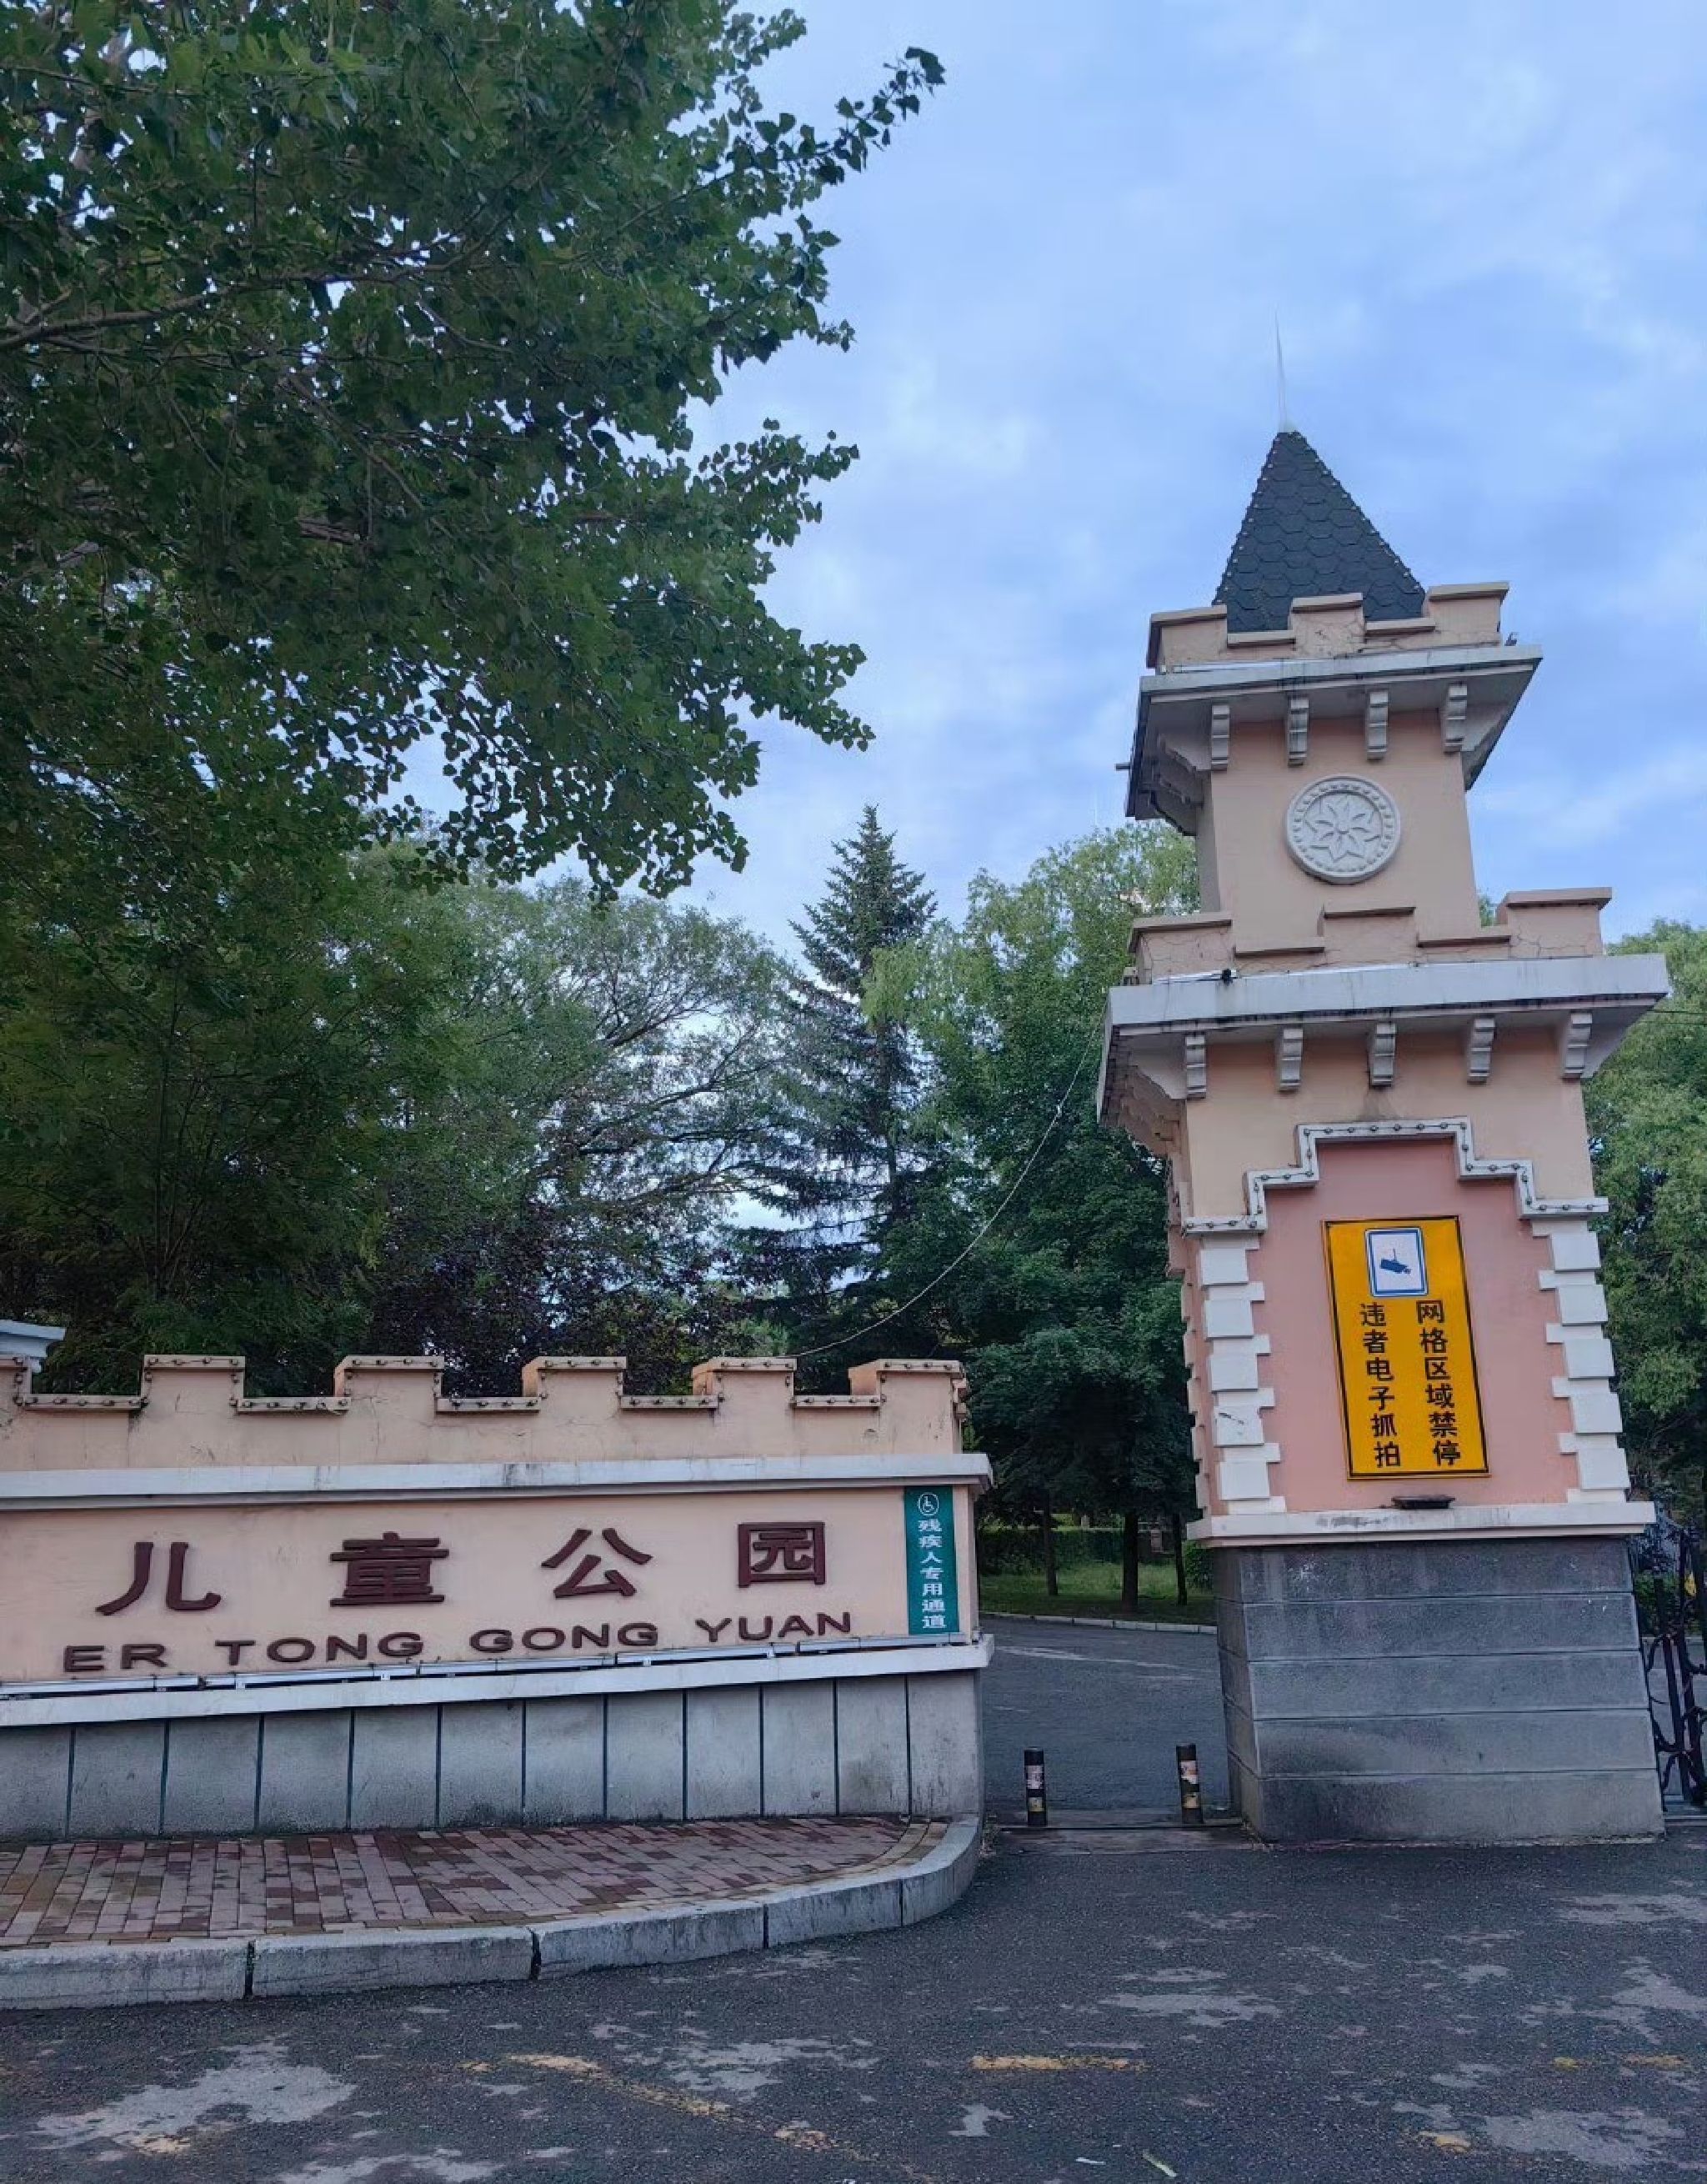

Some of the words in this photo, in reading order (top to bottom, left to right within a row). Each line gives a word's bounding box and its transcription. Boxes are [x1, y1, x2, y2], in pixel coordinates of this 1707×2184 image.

[1360, 1301, 1401, 1468] 违者电子抓拍
[1416, 1300, 1460, 1466] 网格区域禁停
[96, 1521, 827, 1615] 儿童公园
[919, 1518, 947, 1629] 残疾人专用通道
[64, 1644, 167, 1672] ER
[214, 1632, 423, 1667] TONG
[469, 1622, 659, 1653] GONG
[695, 1611, 852, 1643] YUAN
